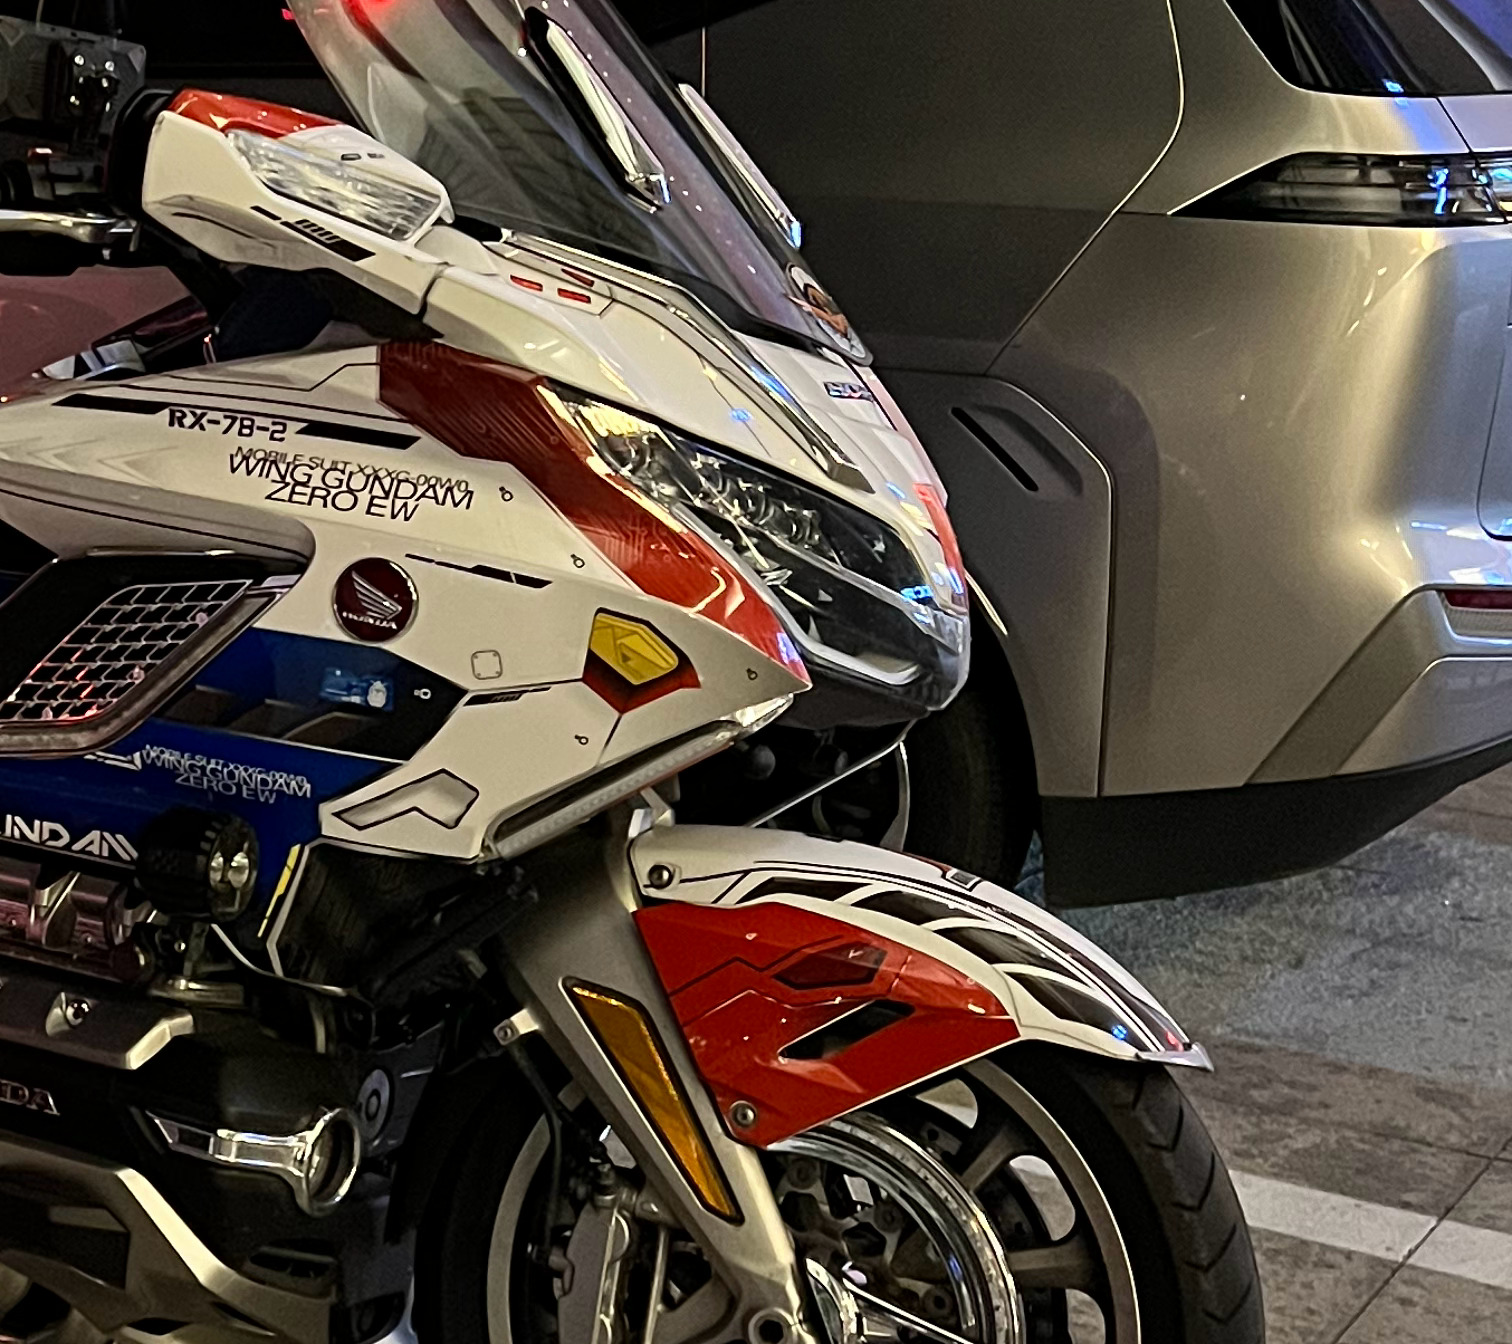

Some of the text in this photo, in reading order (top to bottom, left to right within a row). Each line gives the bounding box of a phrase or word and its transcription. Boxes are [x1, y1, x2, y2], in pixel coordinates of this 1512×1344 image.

[168, 408, 287, 442] RX-78-2
[230, 454, 474, 510] WING GUNDAM
[307, 456, 352, 471] SUIT
[265, 479, 419, 522] ZERO EW
[142, 749, 311, 798] WING GUNDAM
[175, 772, 276, 804] ZERO EW
